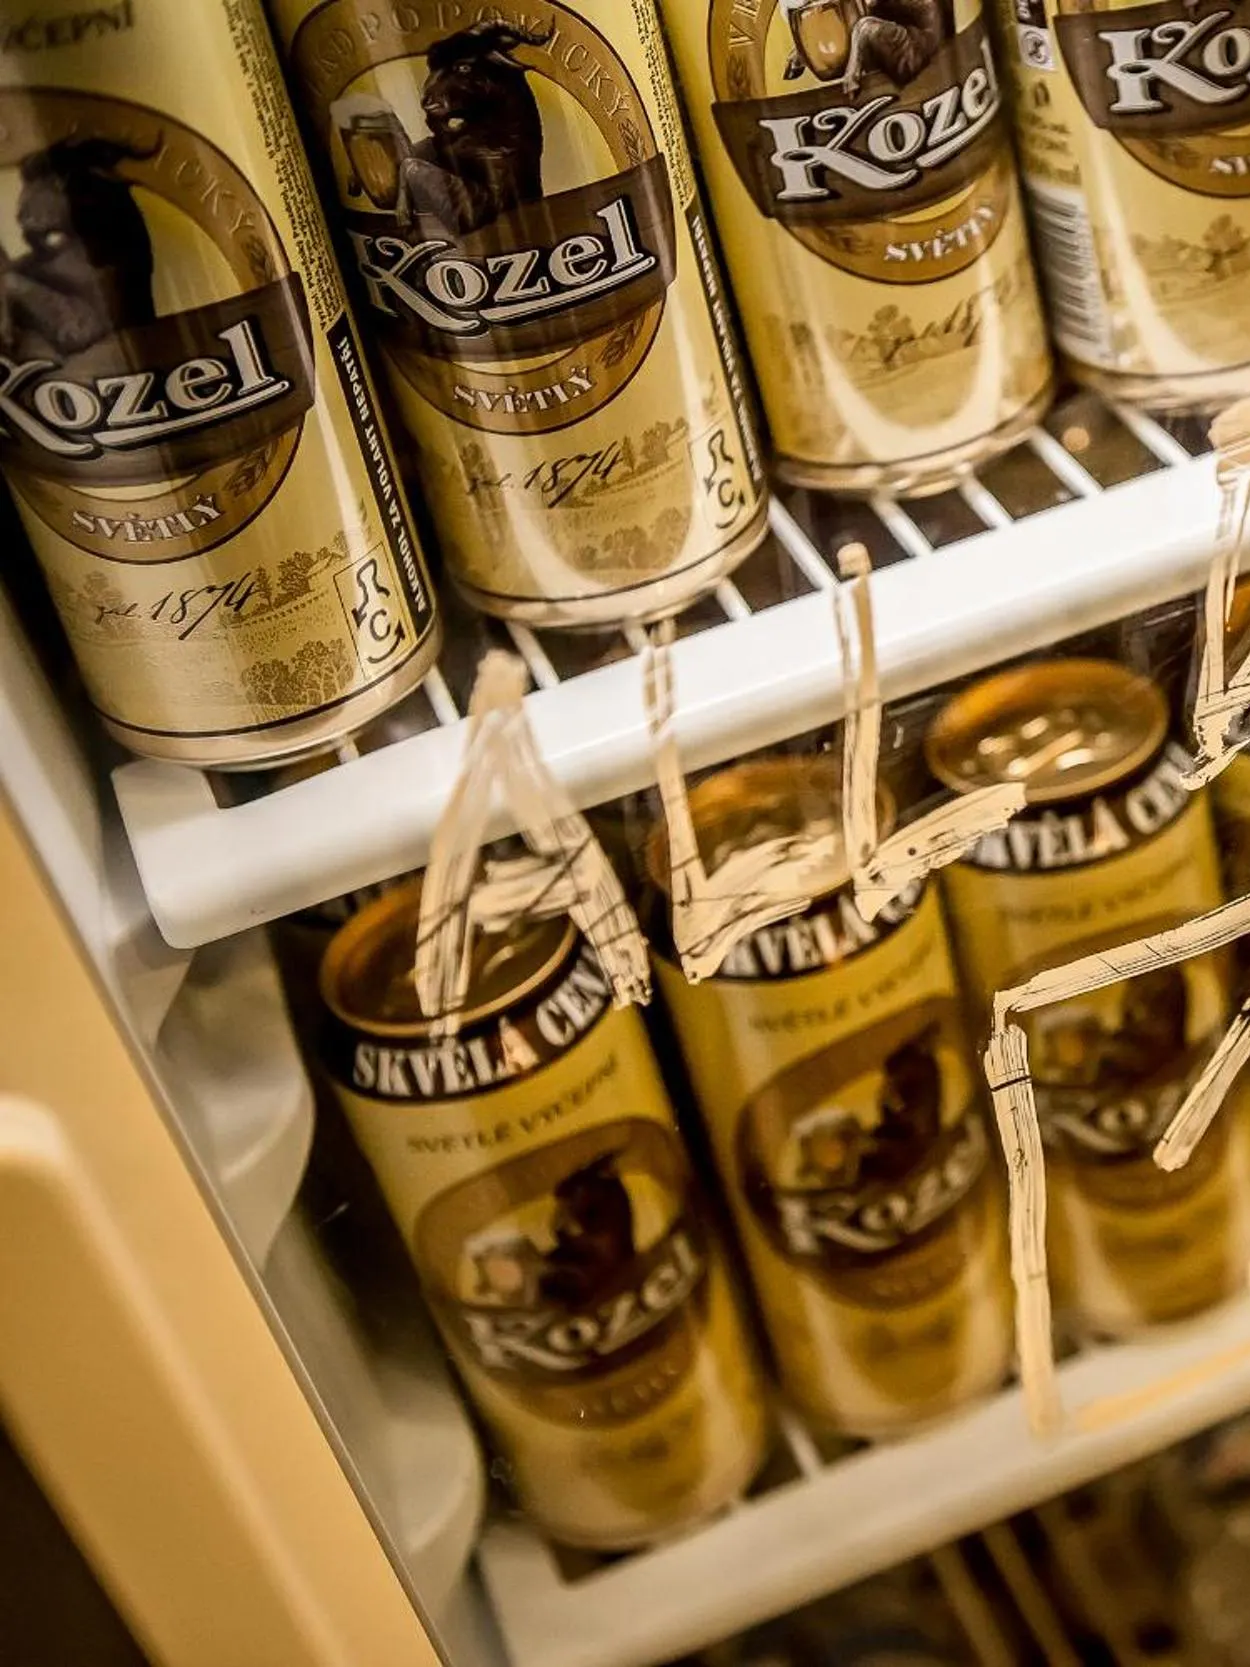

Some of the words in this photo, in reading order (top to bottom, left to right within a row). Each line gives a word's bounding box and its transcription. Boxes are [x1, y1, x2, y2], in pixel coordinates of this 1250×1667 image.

[346, 197, 656, 335] Kozel
[364, 425, 394, 497] VOLANT
[524, 441, 626, 509] 1874
[385, 498, 402, 526] ZA
[150, 571, 262, 641] 1874
[396, 530, 426, 612] ALKOHOL
[413, 541, 1028, 1047] ALL
[535, 943, 612, 1047] CEN
